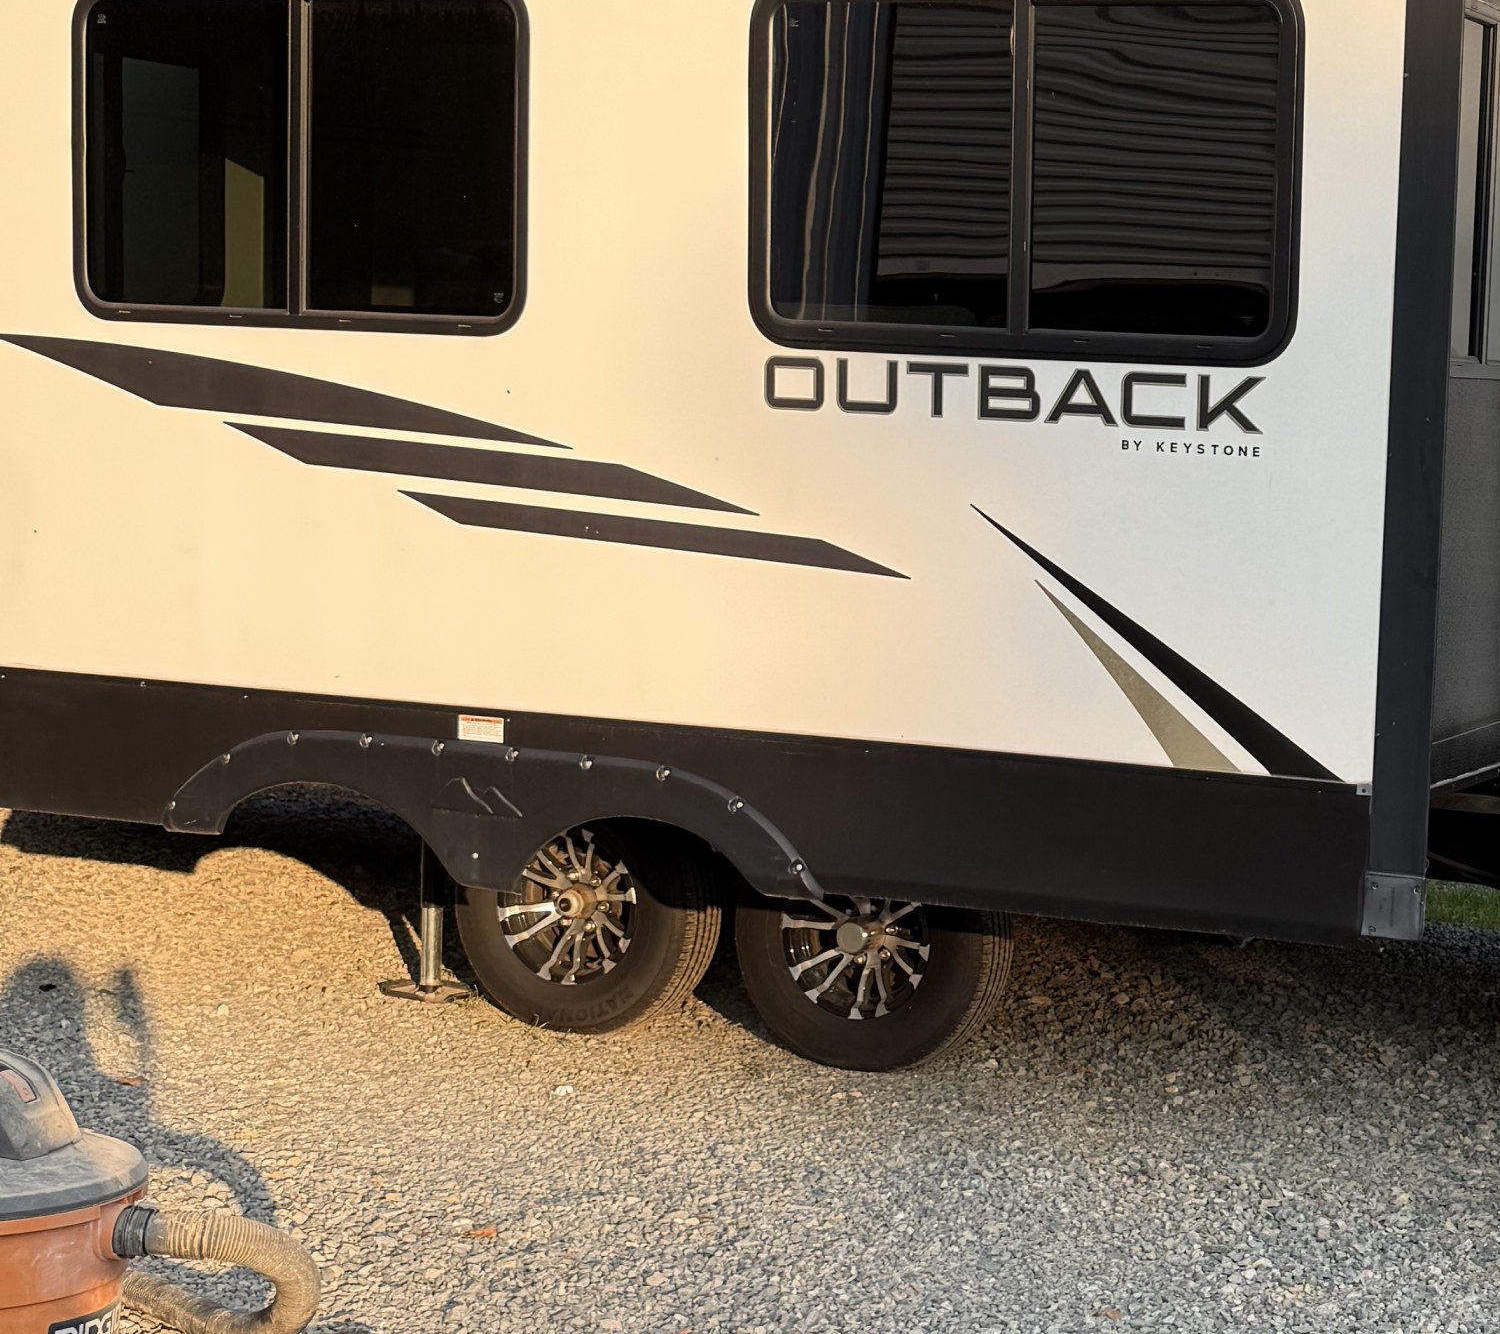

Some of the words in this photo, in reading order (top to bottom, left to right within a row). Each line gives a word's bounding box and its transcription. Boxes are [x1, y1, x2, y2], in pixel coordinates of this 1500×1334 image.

[763, 354, 1266, 435] OUTBACK
[1121, 439, 1143, 451] BY
[1156, 441, 1261, 457] KEYSTONE
[533, 984, 634, 1023] NATIONA
